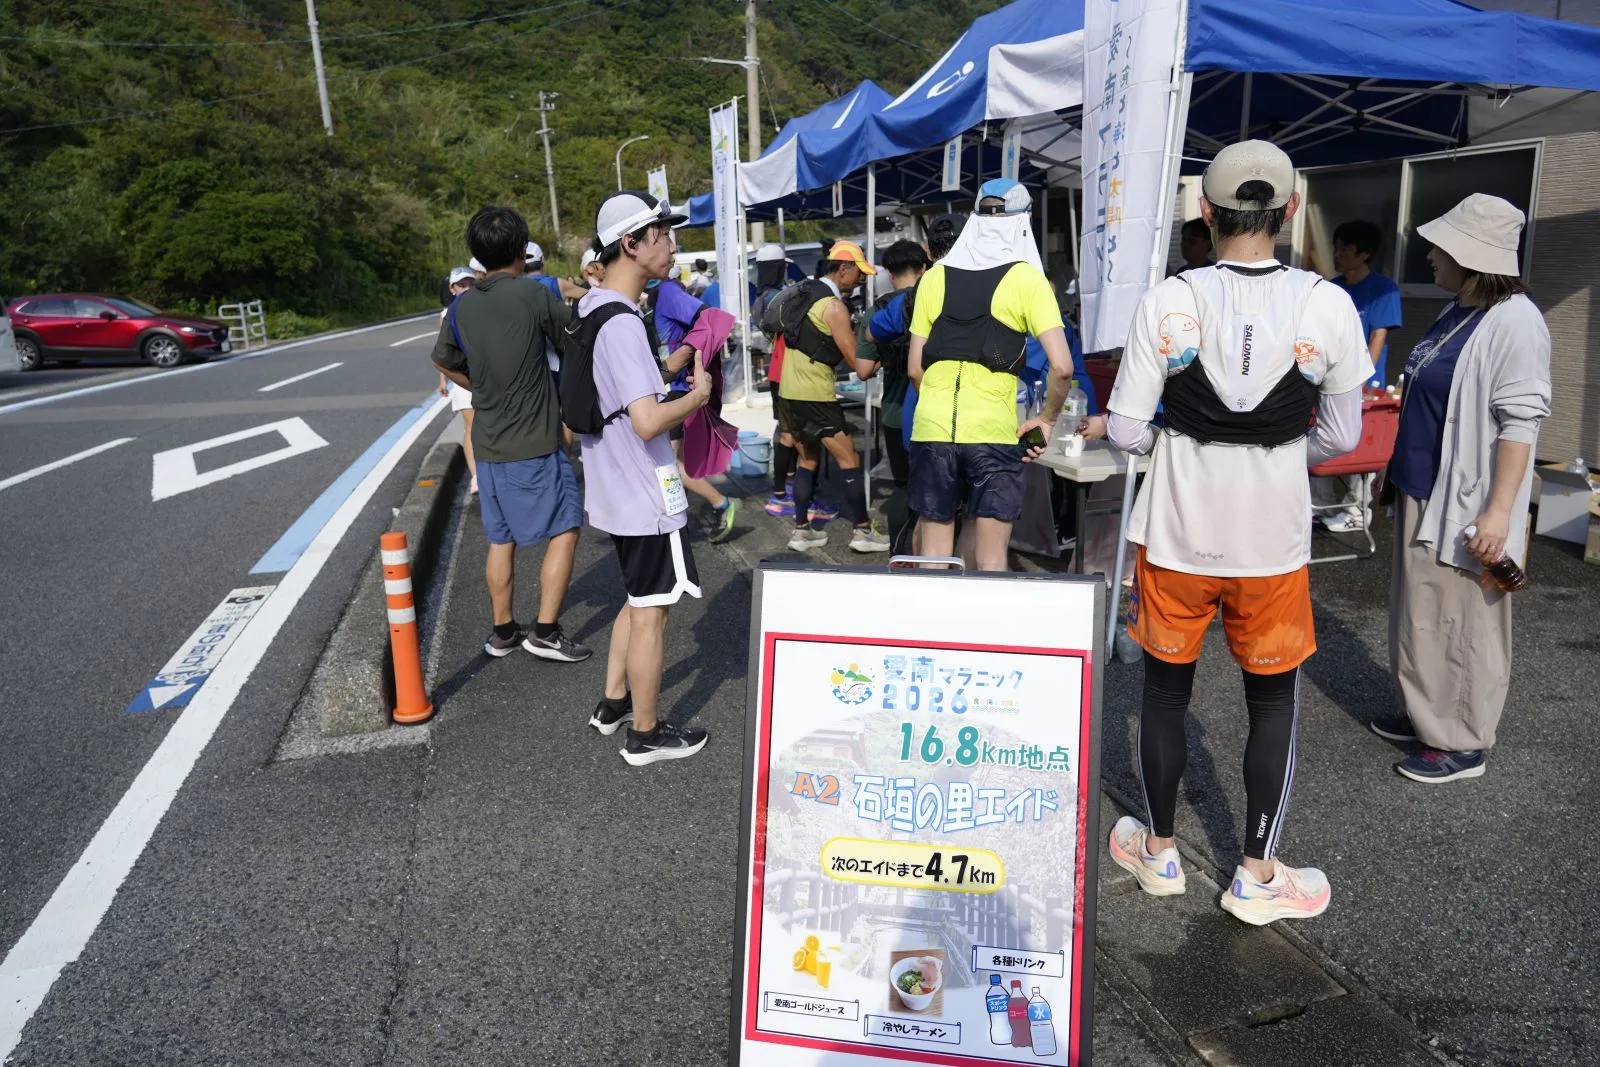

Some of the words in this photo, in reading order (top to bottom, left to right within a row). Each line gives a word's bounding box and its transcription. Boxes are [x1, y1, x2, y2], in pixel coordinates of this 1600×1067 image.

[1241, 324, 1253, 376] SALOMON
[883, 654, 1023, 690] 愛南マラニック
[882, 684, 969, 714] 2026
[900, 722, 1071, 772] 16.8km地点
[790, 771, 841, 806] A2
[853, 774, 1059, 833] 石垣の里エイド
[1257, 813, 1269, 839] TECHFIT
[831, 852, 995, 885] 次のエイドまで4.7km
[992, 955, 1046, 970] 各種ドリンク
[774, 998, 845, 1015] 愛南ゴールドジュース
[1034, 1007, 1046, 1019] 水
[882, 1021, 947, 1038] 冷やしラーメン
